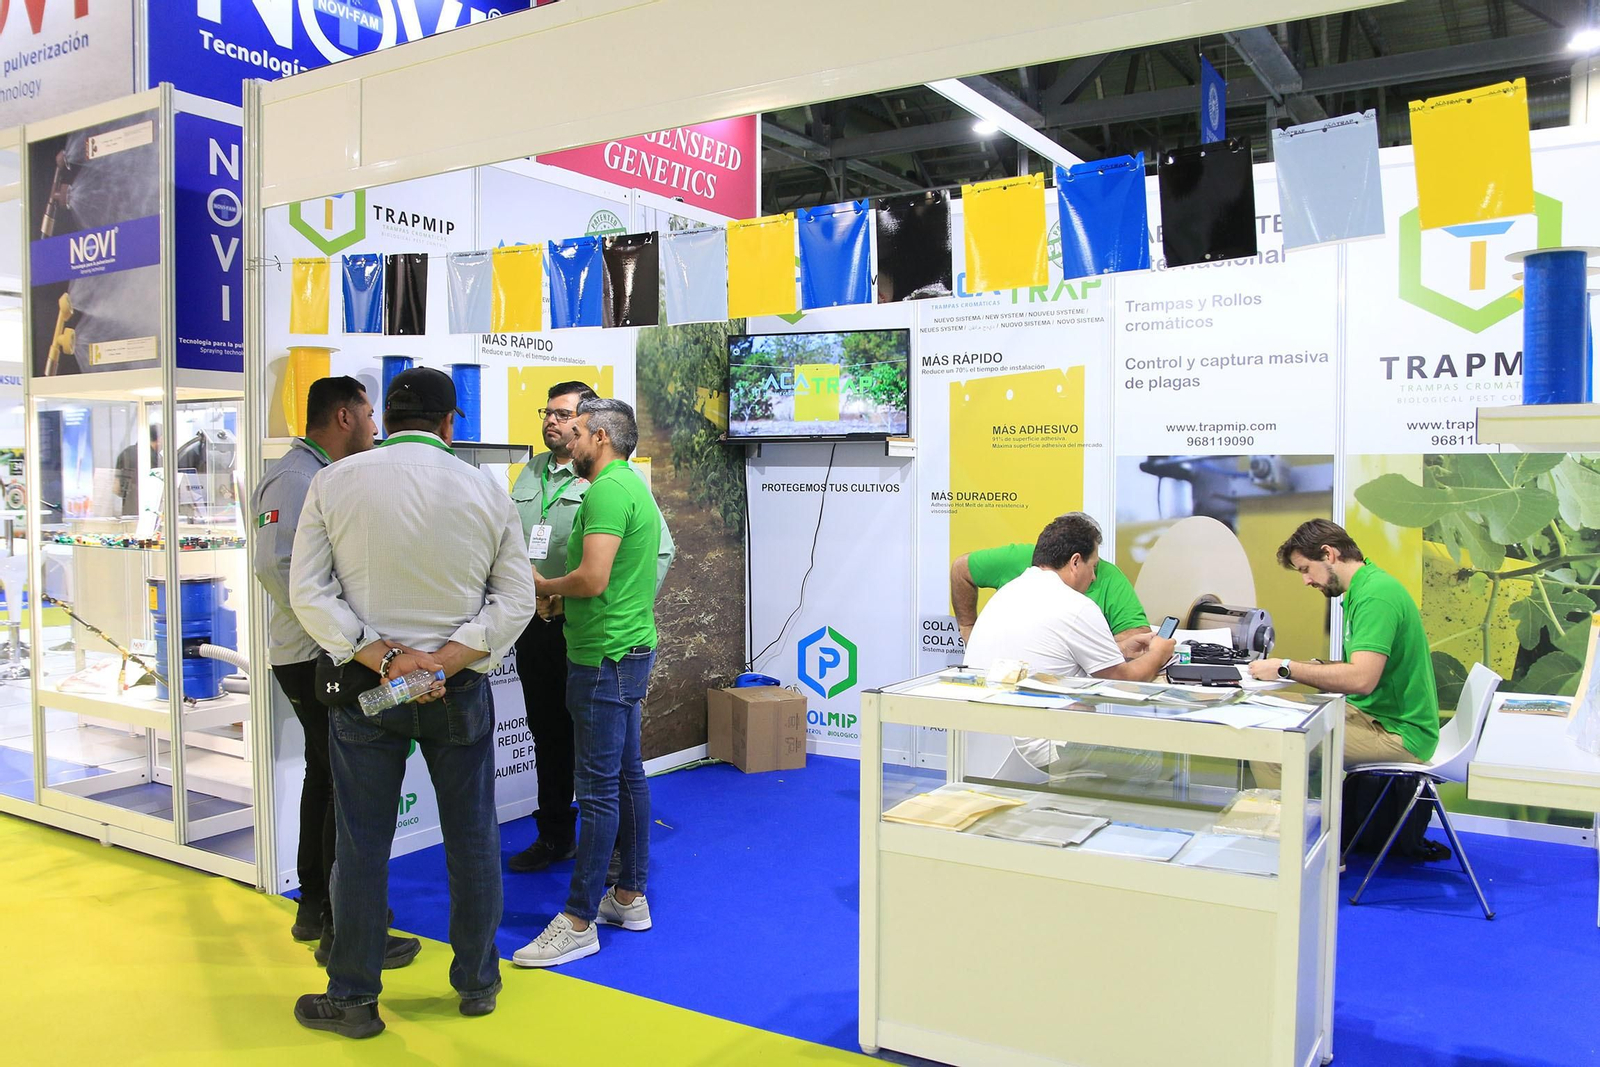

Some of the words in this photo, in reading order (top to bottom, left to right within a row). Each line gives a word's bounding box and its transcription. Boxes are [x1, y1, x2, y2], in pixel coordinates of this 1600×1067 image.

[318, 0, 380, 30] NOVI-FAM
[4, 30, 89, 78] pulverización
[603, 141, 718, 200] GENETICS
[372, 204, 455, 235] TRAPMIP
[70, 229, 116, 264] NOVI
[1125, 299, 1194, 314] Trampas
[1198, 298, 1207, 312] y
[1211, 293, 1262, 308] Rollos
[919, 326, 940, 334] NEUES
[940, 325, 964, 333] SYSTEM
[1000, 321, 1023, 329] NUOVO
[1024, 319, 1051, 327] SISTEMA
[1076, 316, 1105, 324] SISTEMA
[934, 316, 955, 324] NUEVO
[1125, 316, 1214, 332] cromáticos
[510, 334, 554, 352] RÁPIDO
[481, 346, 504, 356] Reduce
[531, 353, 550, 361] tiempo
[550, 354, 558, 362] de
[921, 353, 949, 367] MÁS
[952, 352, 1003, 366] RÁPIDO
[1125, 355, 1183, 371] Control
[1187, 357, 1196, 371] y
[1200, 353, 1264, 369] captura
[1268, 350, 1329, 365] masiva
[976, 366, 999, 374] tiempo
[1125, 377, 1144, 389] de
[1148, 375, 1201, 392] plagas
[1400, 383, 1459, 393] TRAMPAS
[992, 423, 1016, 435] MÁS
[1018, 424, 1079, 435] ADHESIVO
[1165, 421, 1277, 433] www.trapmip.com
[1186, 436, 1255, 447] 968119090
[761, 483, 827, 493] PROTEGEMOS
[829, 483, 848, 492] TUS
[850, 483, 900, 493] CULTIVOS
[931, 489, 954, 501] MÁS
[956, 491, 1018, 502] DURADERO
[922, 620, 955, 632] COLA
[922, 634, 955, 646] COLA
[922, 645, 945, 653] Sistema
[806, 710, 858, 729] OLMIP
[512, 746, 526, 760] DE
[397, 816, 419, 829] OGICO
